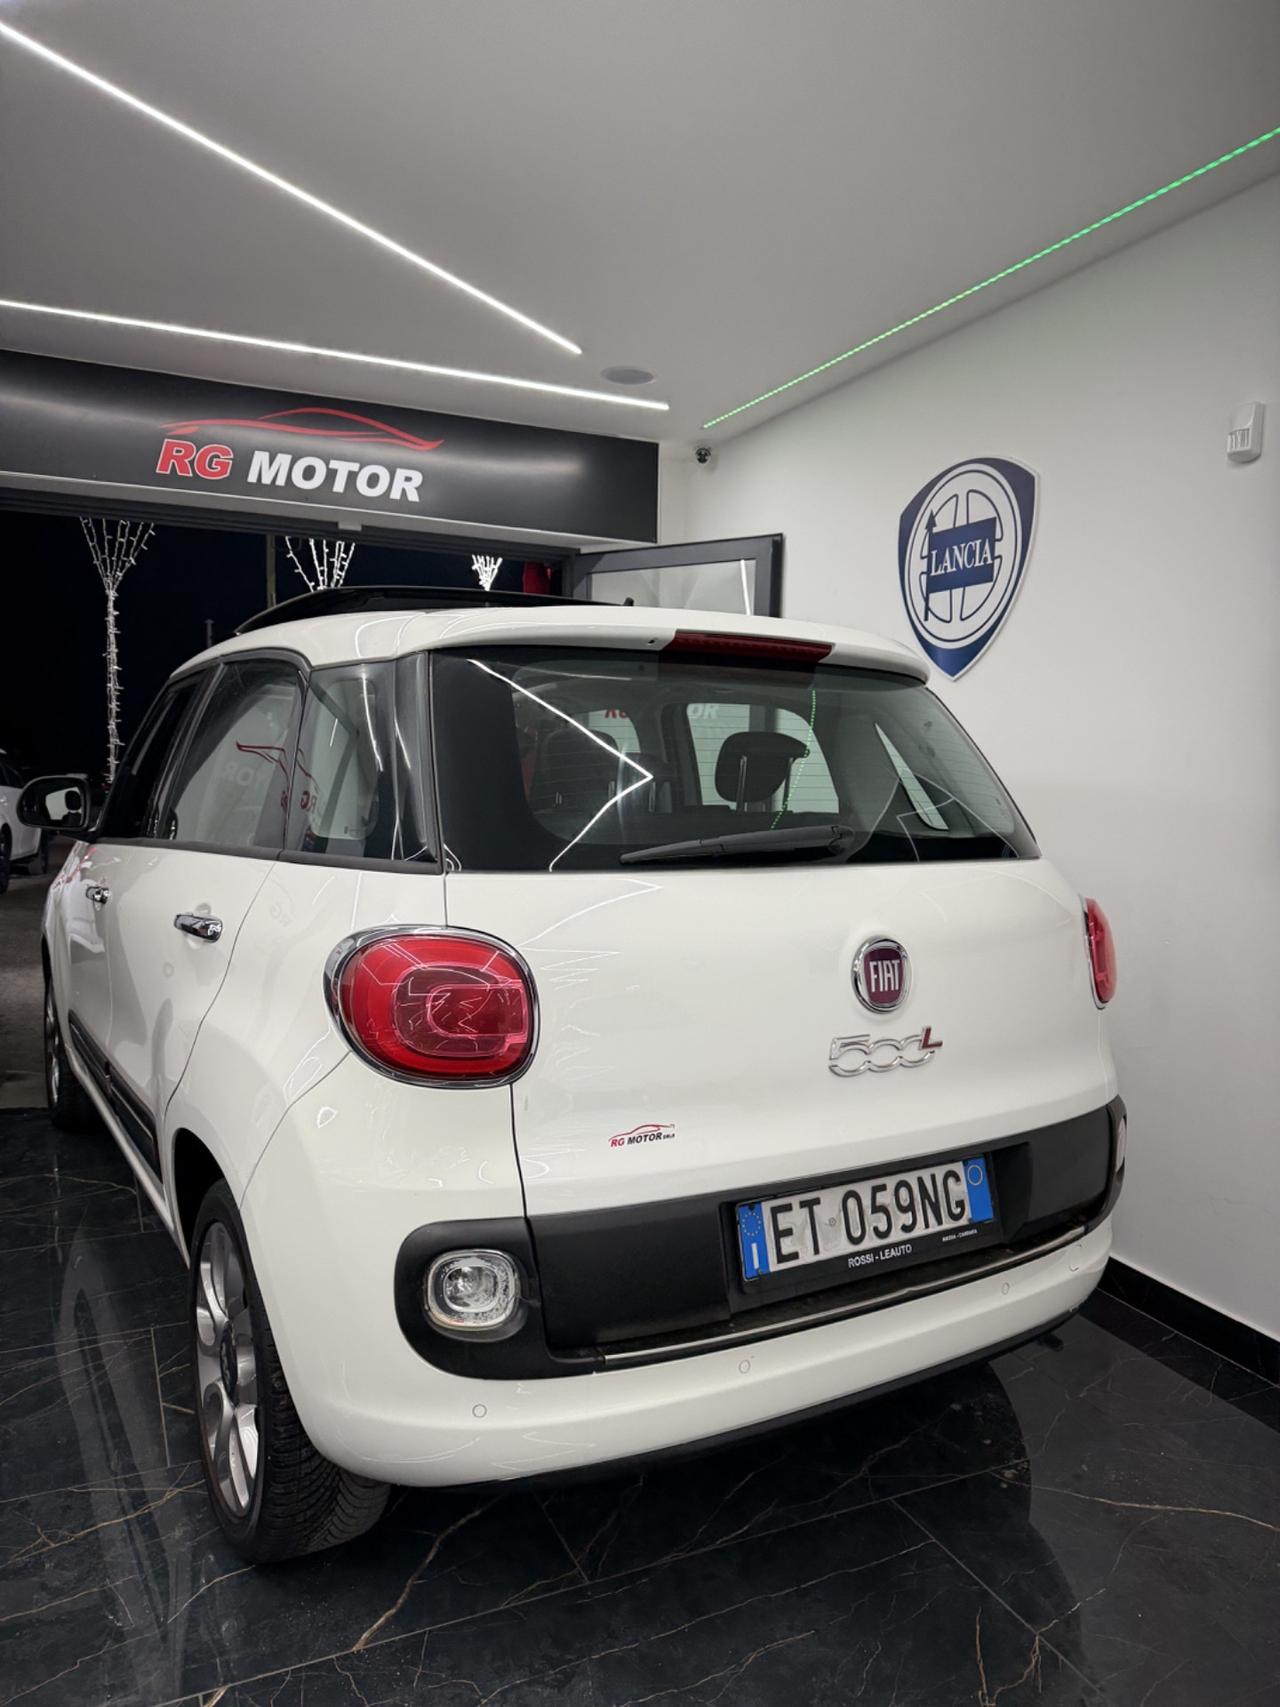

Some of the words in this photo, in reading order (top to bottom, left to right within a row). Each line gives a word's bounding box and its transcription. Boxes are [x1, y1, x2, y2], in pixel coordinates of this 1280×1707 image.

[156, 438, 234, 480] RG
[247, 450, 424, 502] MOTOR
[930, 538, 993, 576] LANCIA
[869, 960, 900, 993] FIAT
[829, 1026, 943, 1078] 500L
[610, 1138, 625, 1148] RG
[627, 1132, 663, 1145] MOTOR
[770, 1197, 821, 1265] ET
[841, 1169, 966, 1246] 059NG
[848, 1253, 875, 1268] ROSSI
[879, 1244, 913, 1261] LEAUTO
